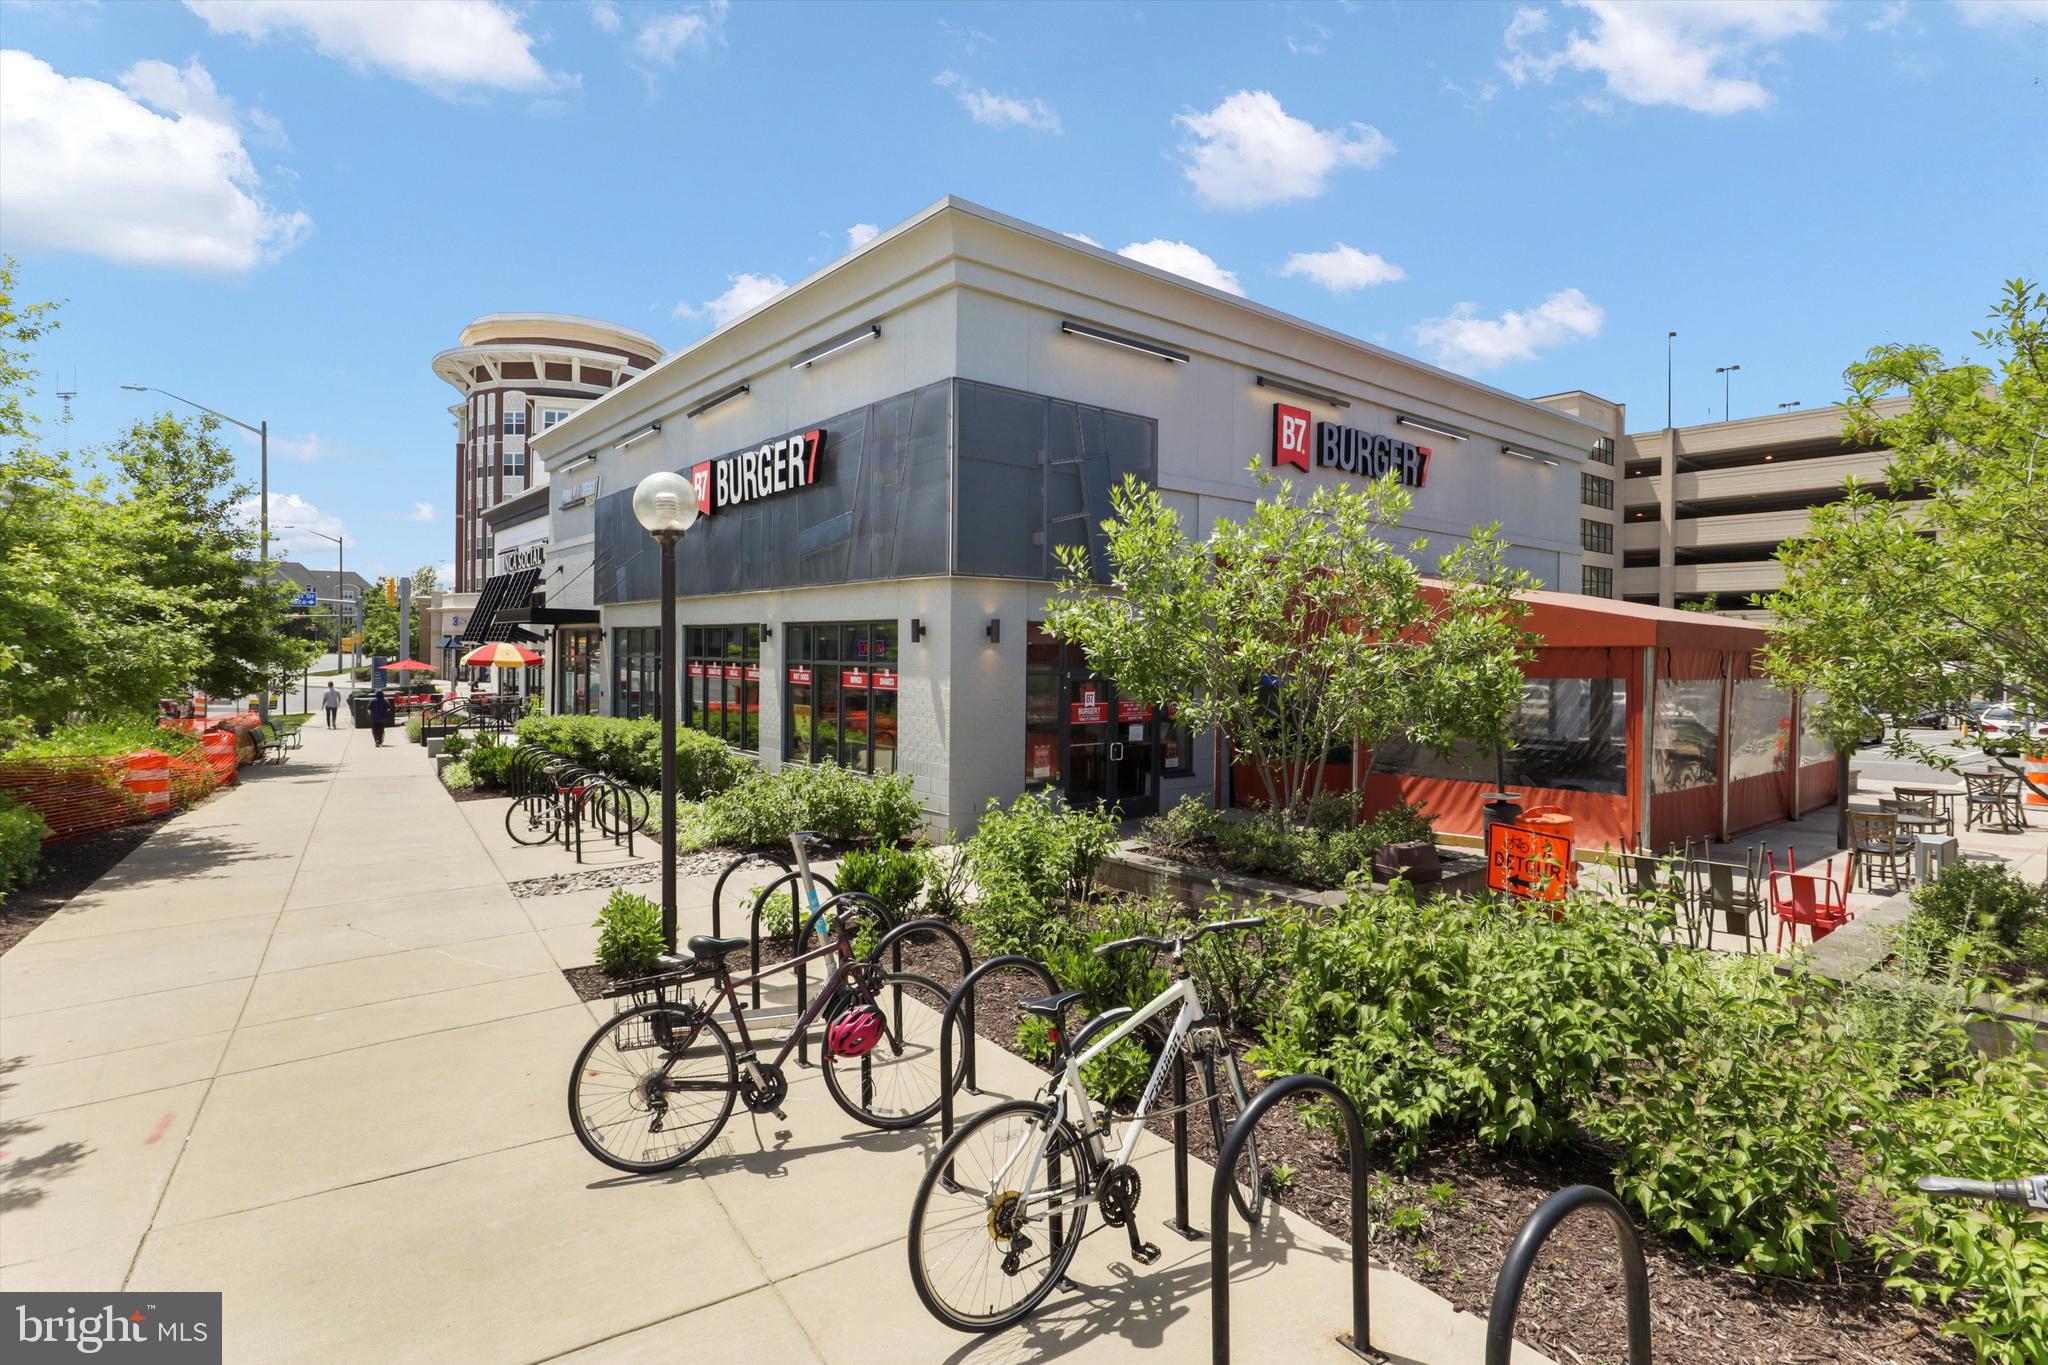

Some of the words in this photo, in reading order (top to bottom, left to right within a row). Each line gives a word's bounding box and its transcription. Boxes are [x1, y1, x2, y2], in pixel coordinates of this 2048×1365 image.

[717, 429, 821, 507] BURGER7
[694, 470, 709, 502] B7
[1495, 851, 1561, 881] DETOUR
